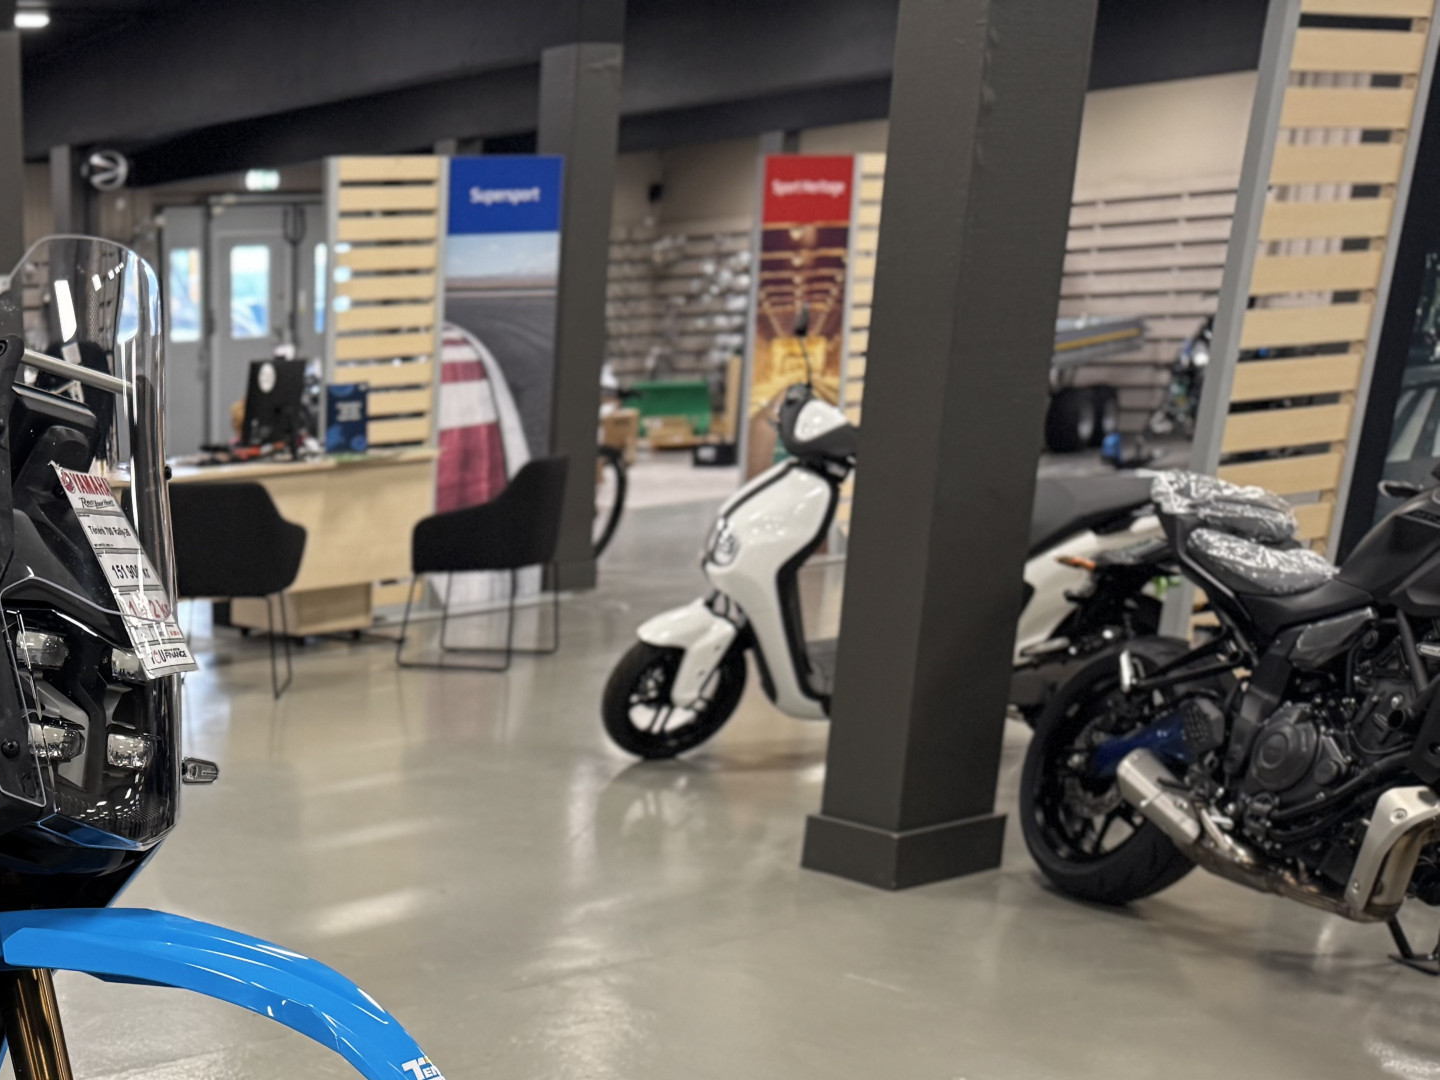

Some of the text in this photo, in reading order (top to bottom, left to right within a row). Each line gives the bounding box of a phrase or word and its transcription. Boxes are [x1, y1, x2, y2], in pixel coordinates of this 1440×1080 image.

[469, 186, 540, 206] Supersport
[771, 179, 801, 197] Sport
[70, 472, 111, 497] YAMAHA
[111, 564, 129, 580] 151
